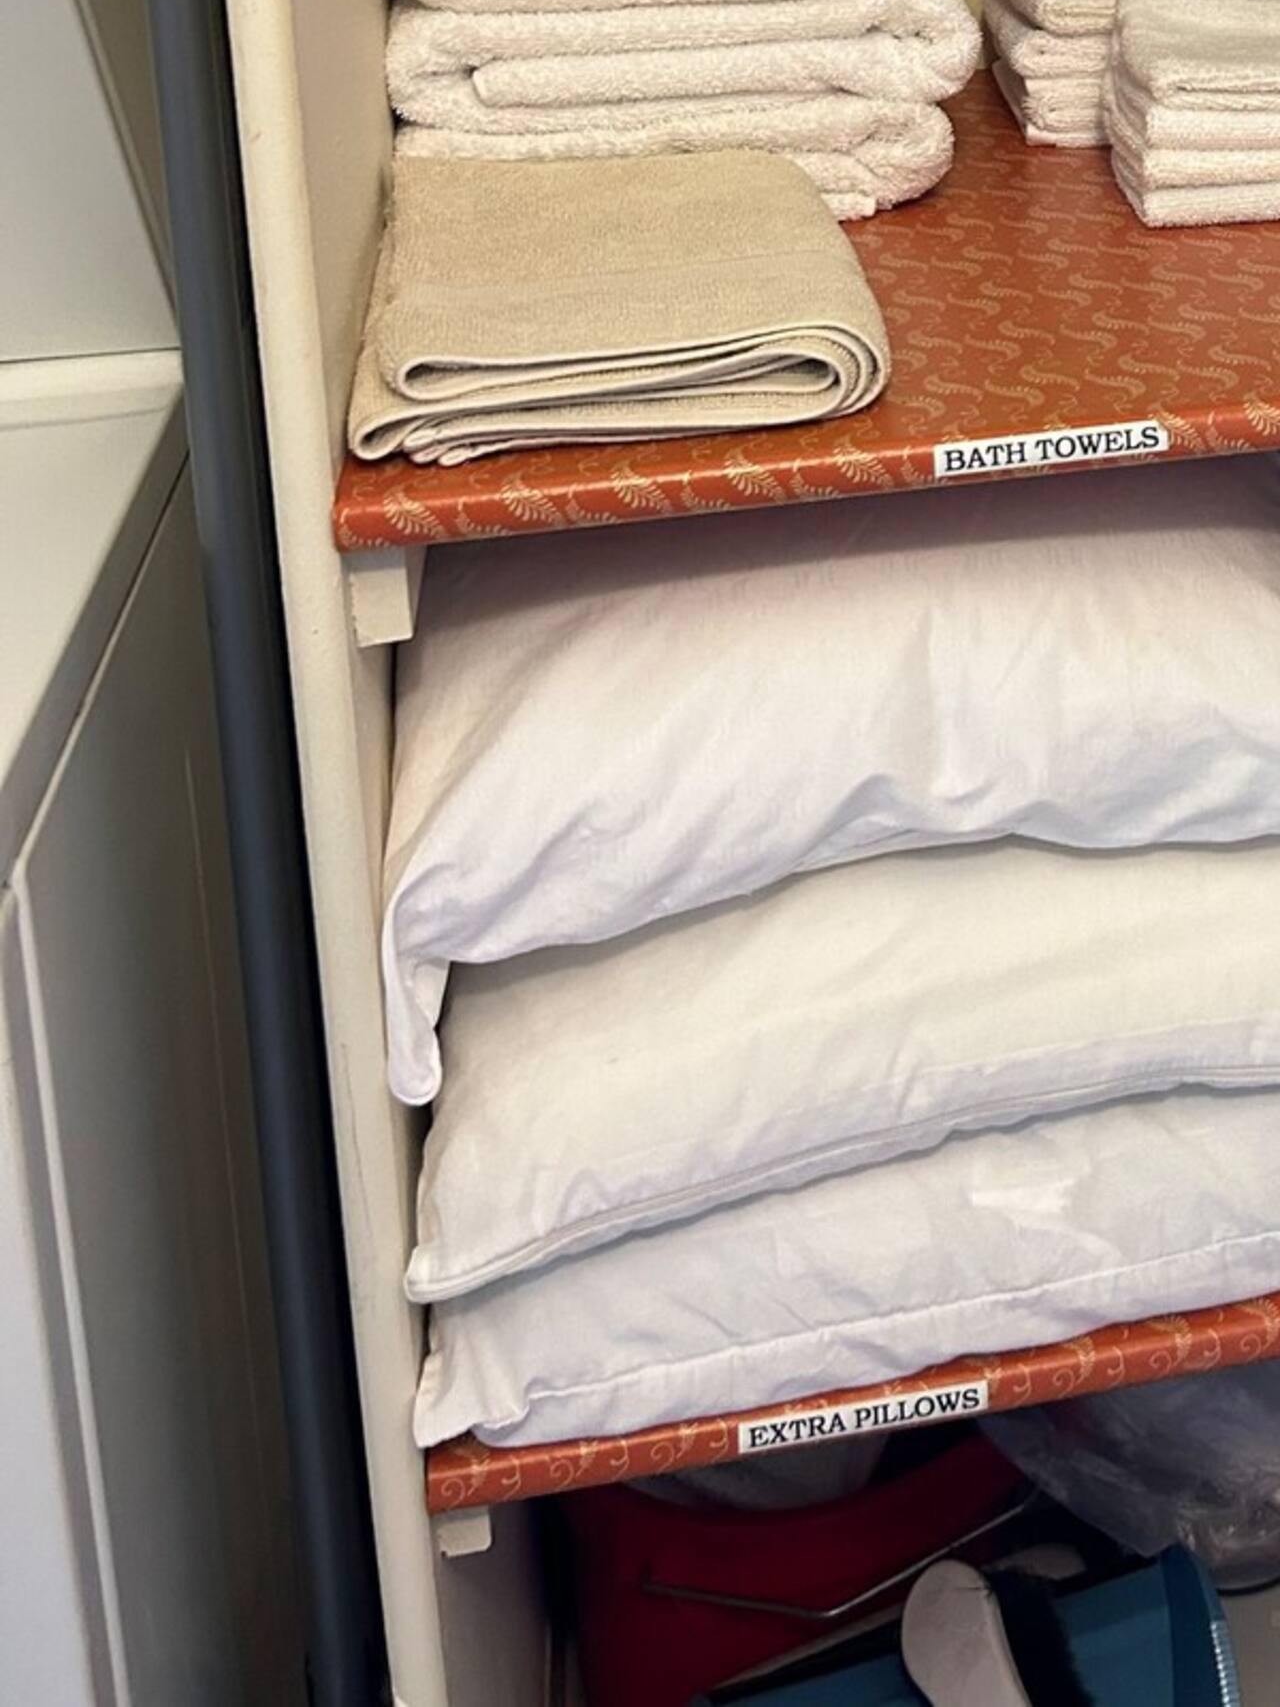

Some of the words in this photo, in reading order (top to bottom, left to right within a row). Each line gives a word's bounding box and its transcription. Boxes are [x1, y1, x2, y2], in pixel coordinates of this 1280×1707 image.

[944, 441, 1027, 472] BATH
[1034, 426, 1160, 460] TOWELS
[749, 1412, 847, 1448] EXTRA
[854, 1388, 980, 1429] PILLOWS
